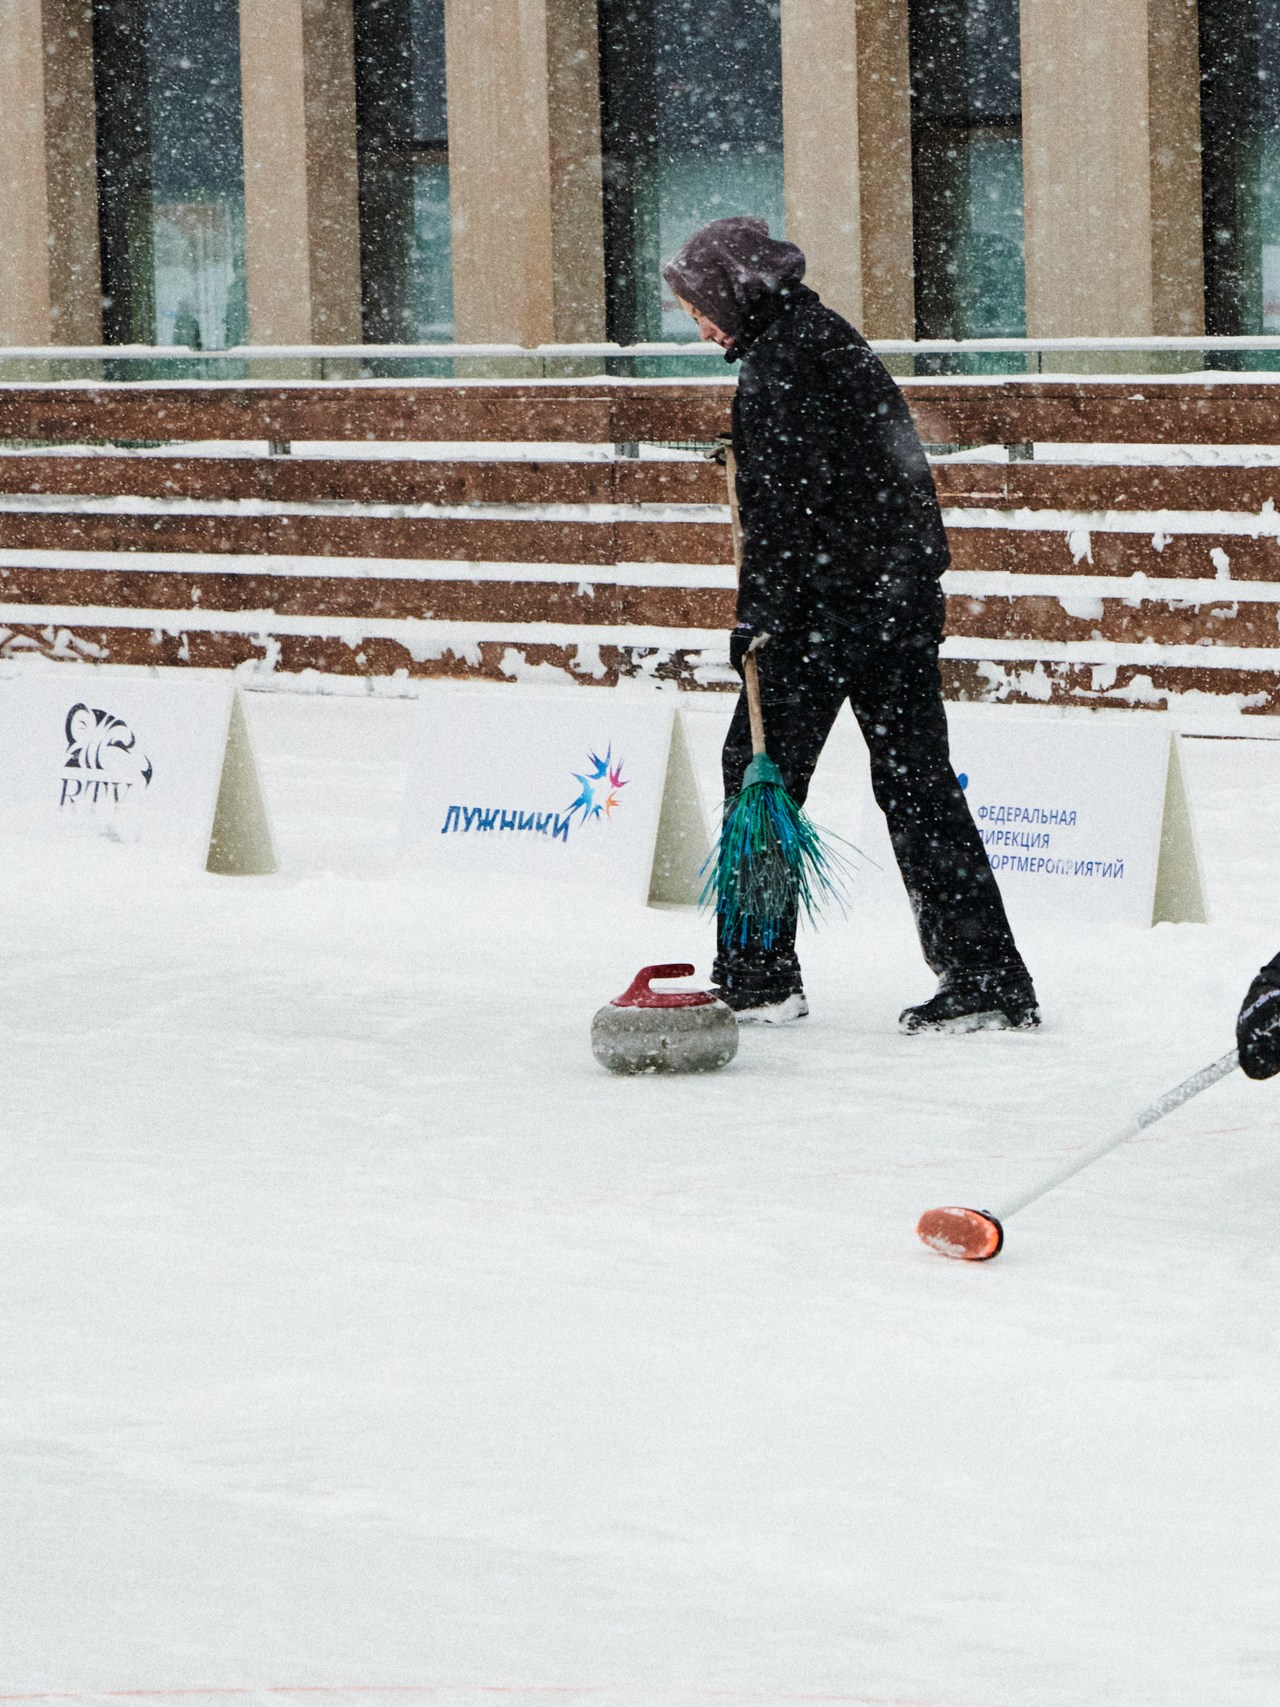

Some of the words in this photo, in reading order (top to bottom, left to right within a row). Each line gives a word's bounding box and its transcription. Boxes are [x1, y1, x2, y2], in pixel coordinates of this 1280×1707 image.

[441, 805, 571, 843] ЛУЖНИКИ
[977, 805, 1077, 826] ФЕДЕРАЛЬНАЯ
[987, 856, 1124, 879] ОРТМЕРОПРИЯТИЙ
